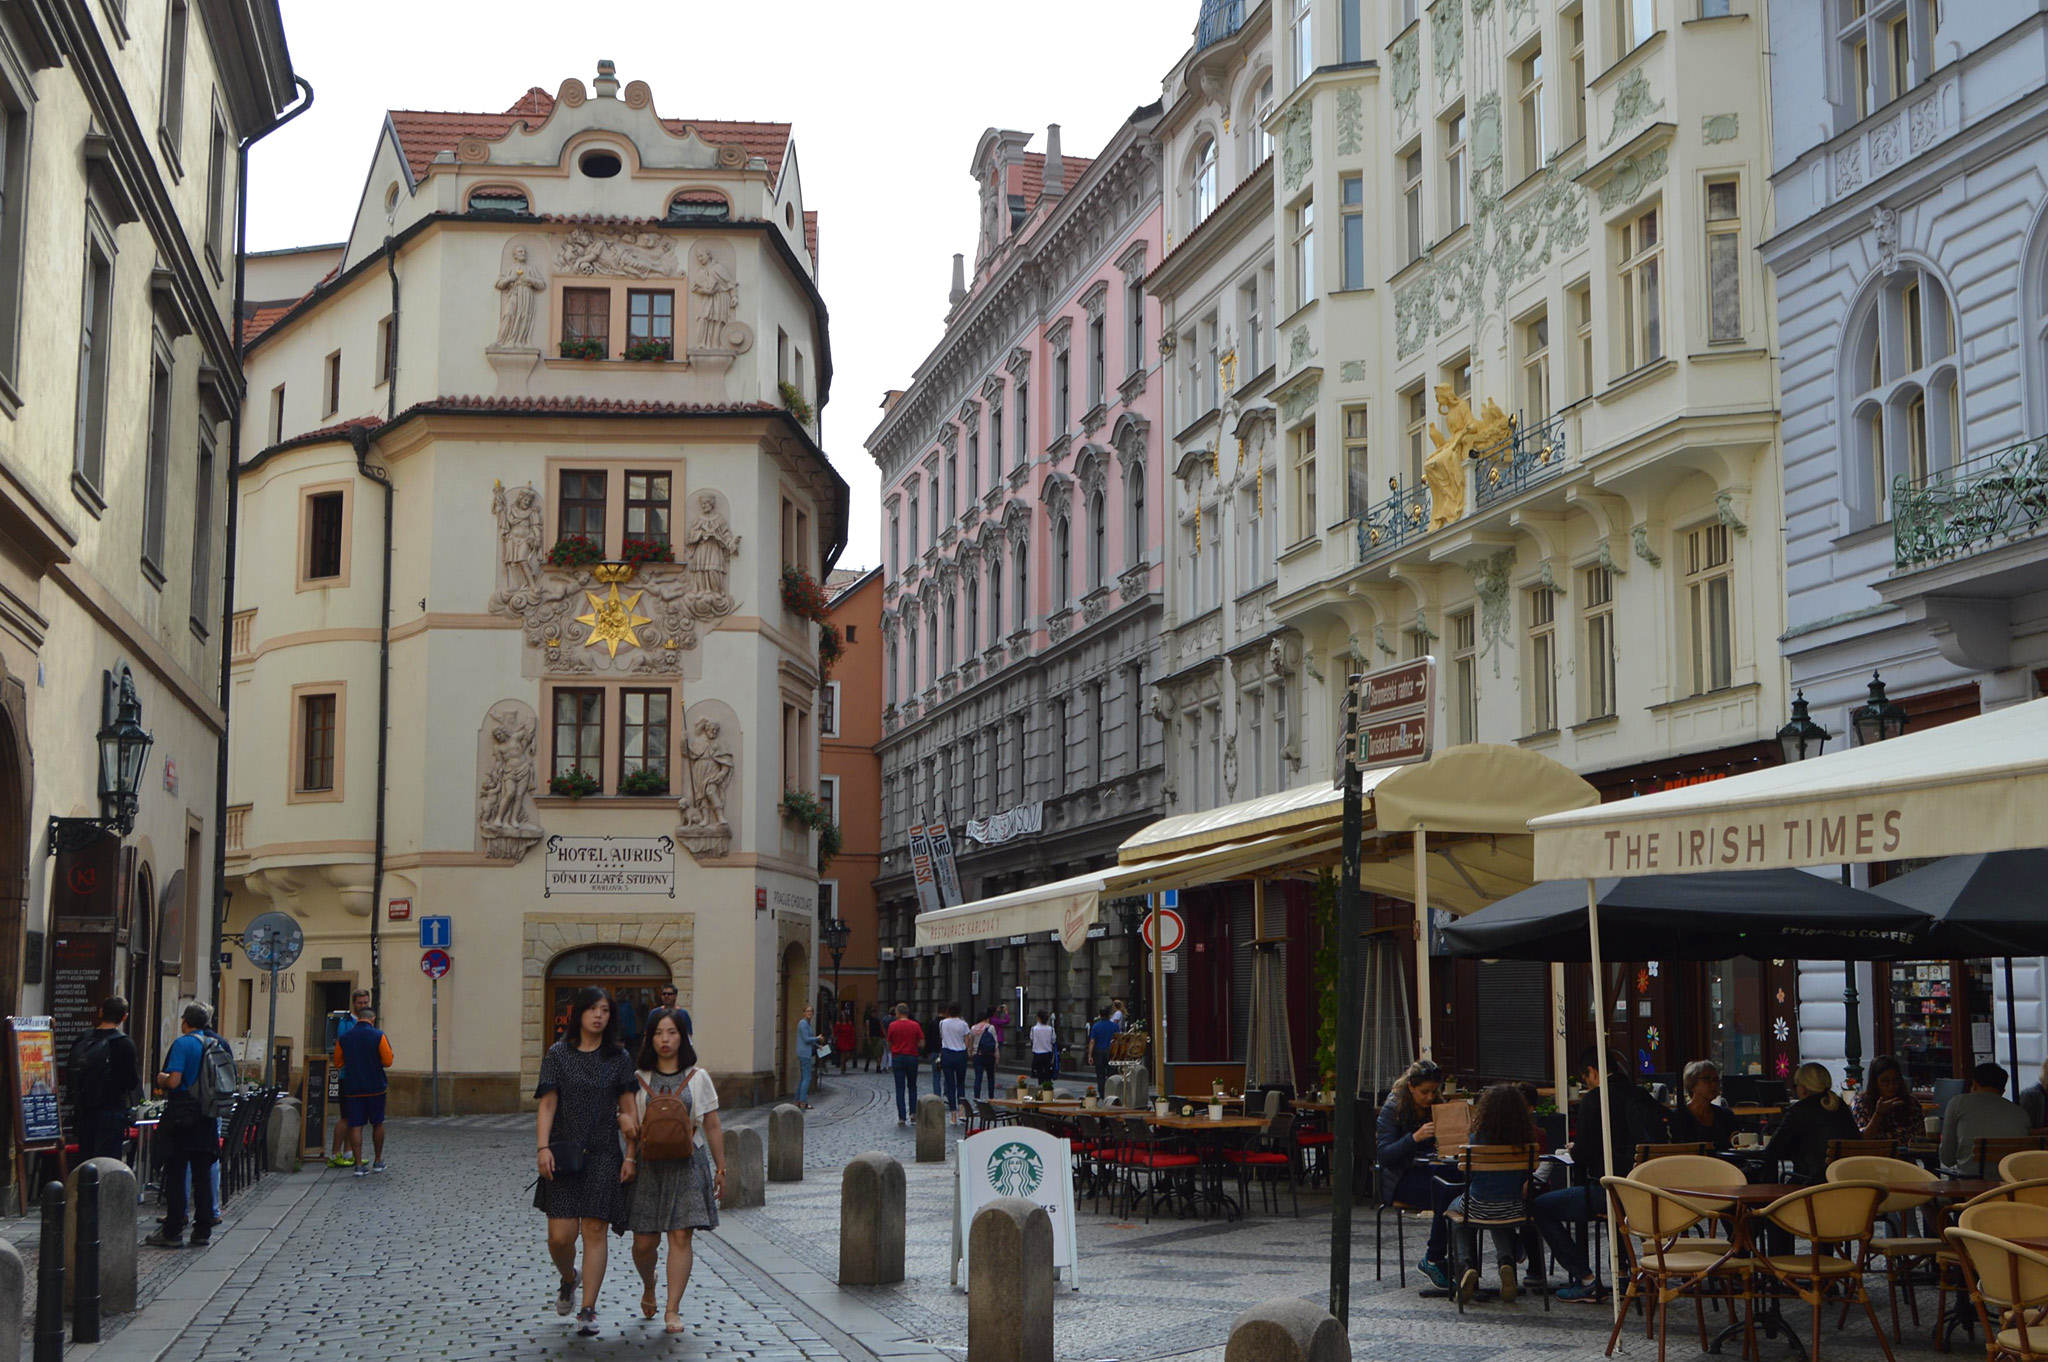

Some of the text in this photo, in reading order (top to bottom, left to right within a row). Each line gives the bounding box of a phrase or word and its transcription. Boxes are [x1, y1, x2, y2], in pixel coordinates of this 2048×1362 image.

[1398, 676, 1414, 700] radnice
[1390, 730, 1413, 753] inforace
[1604, 810, 1902, 871] THE IRISH TIMES
[558, 847, 663, 862] HOTEL AURUS
[552, 871, 670, 885] DŮM U ZLATÉ STUDNY
[930, 923, 965, 941] RESTAURACE
[967, 919, 995, 934] KARLOVA
[1859, 929, 1915, 945] COFFEE
[576, 951, 643, 975] PRAGUE CHOCOLATE
